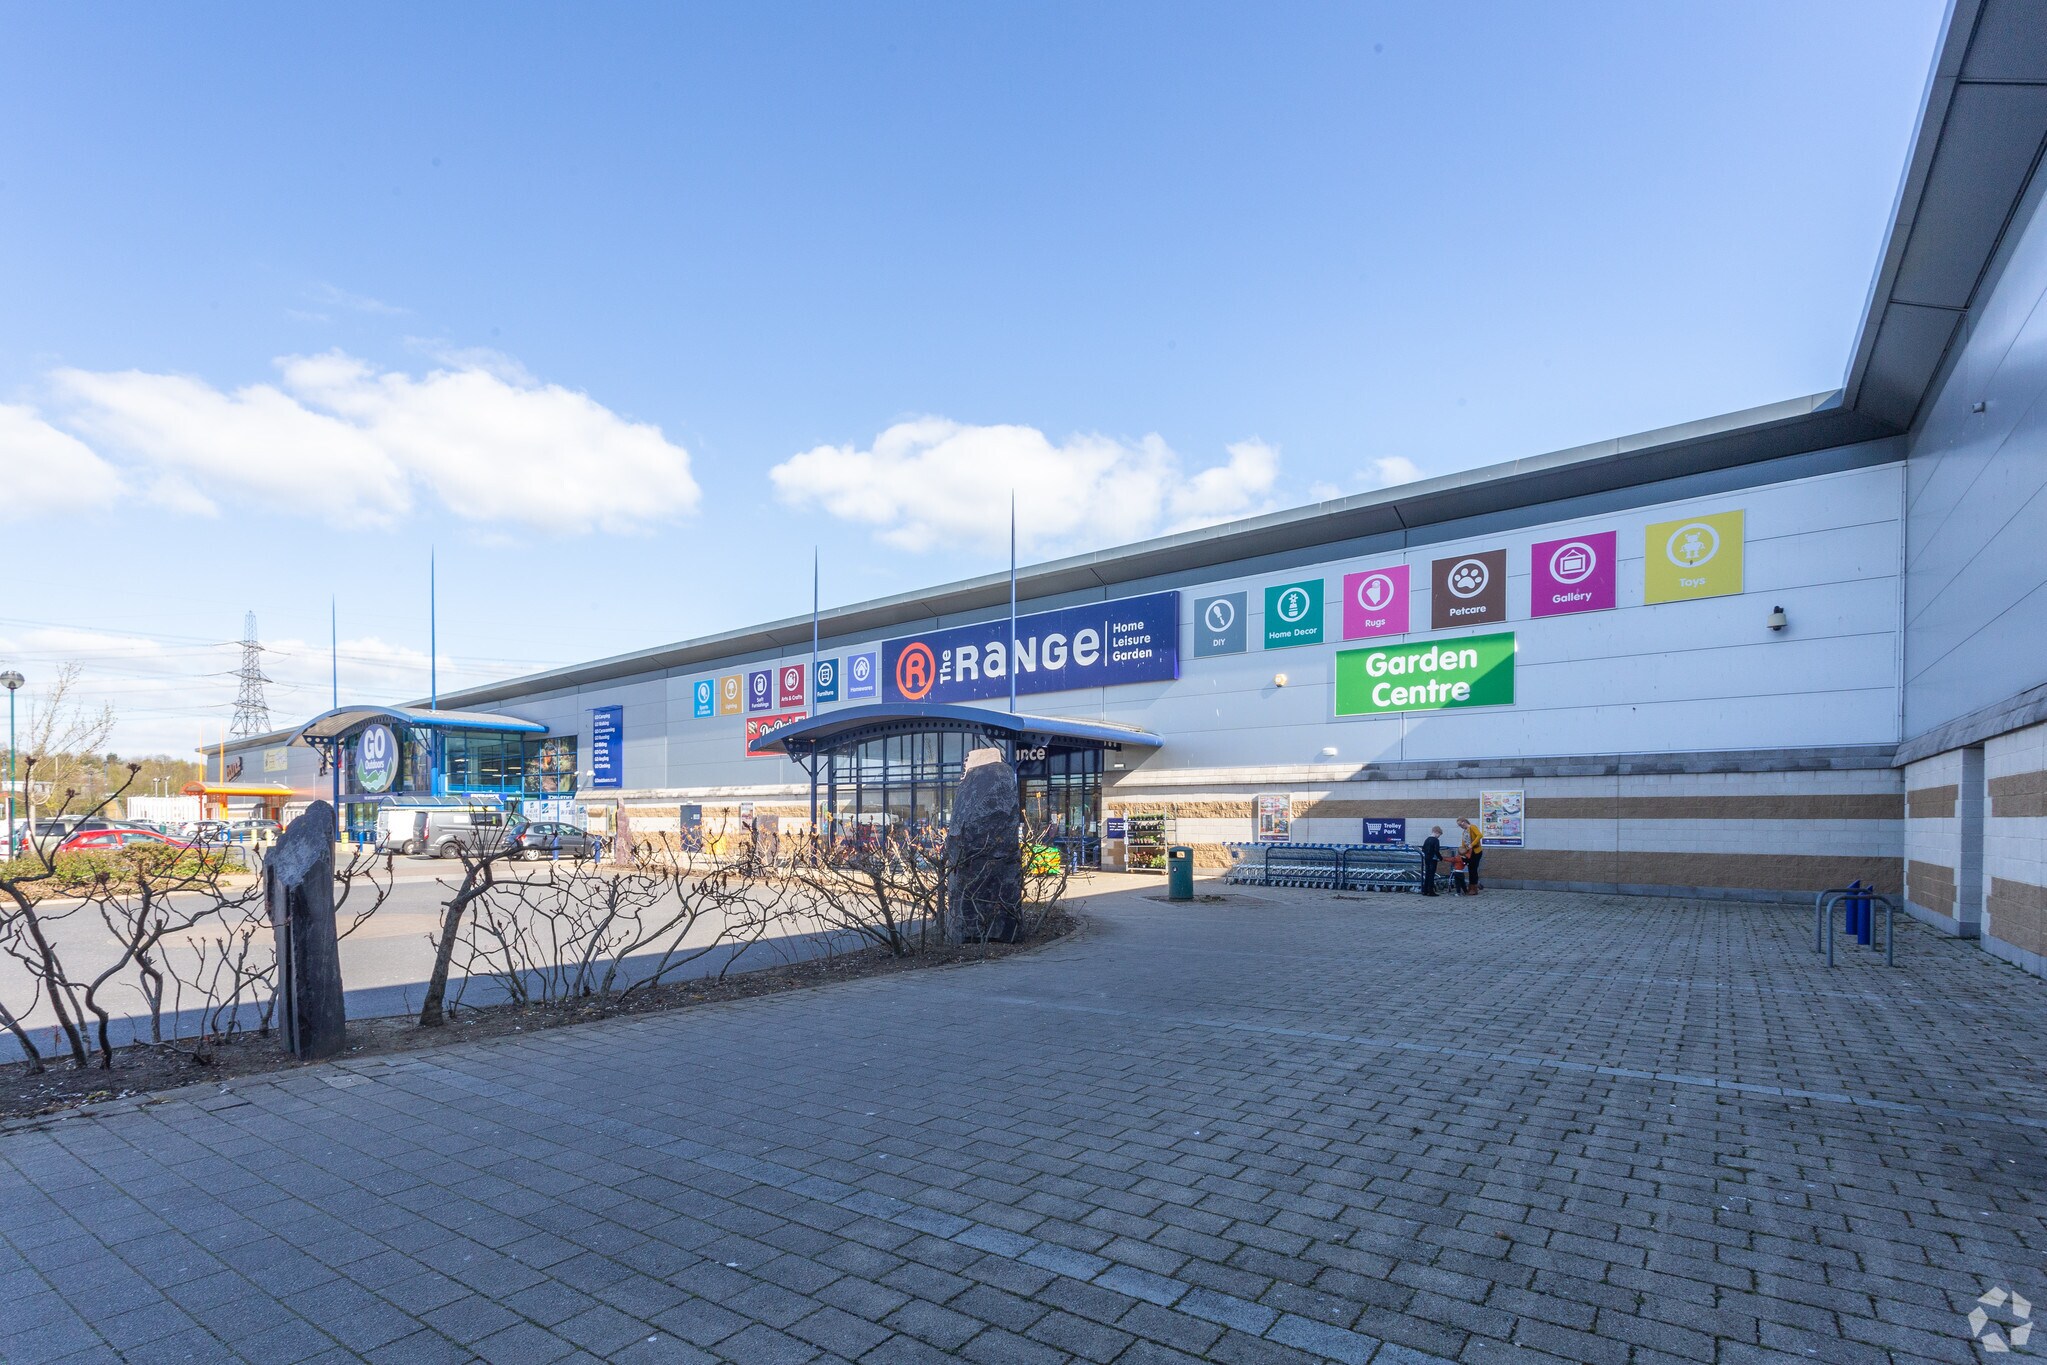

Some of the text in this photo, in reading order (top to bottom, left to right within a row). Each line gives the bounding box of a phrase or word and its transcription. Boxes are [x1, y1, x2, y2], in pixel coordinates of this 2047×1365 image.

[1679, 576, 1706, 588] Toys
[1552, 590, 1592, 604] Gallery
[1450, 604, 1487, 616] Petcare
[1113, 621, 1144, 634] Home
[1365, 618, 1386, 628] Rugs
[1269, 627, 1318, 639] Home Decor
[1113, 634, 1151, 648] Leisure
[1213, 638, 1226, 647] DIY
[1113, 648, 1152, 662] Garden
[1366, 646, 1477, 677] Garden
[939, 649, 951, 685] The
[850, 685, 873, 693] Homewares
[1372, 678, 1471, 707] Centre
[364, 728, 386, 760] GO
[365, 760, 384, 770] Outdoors
